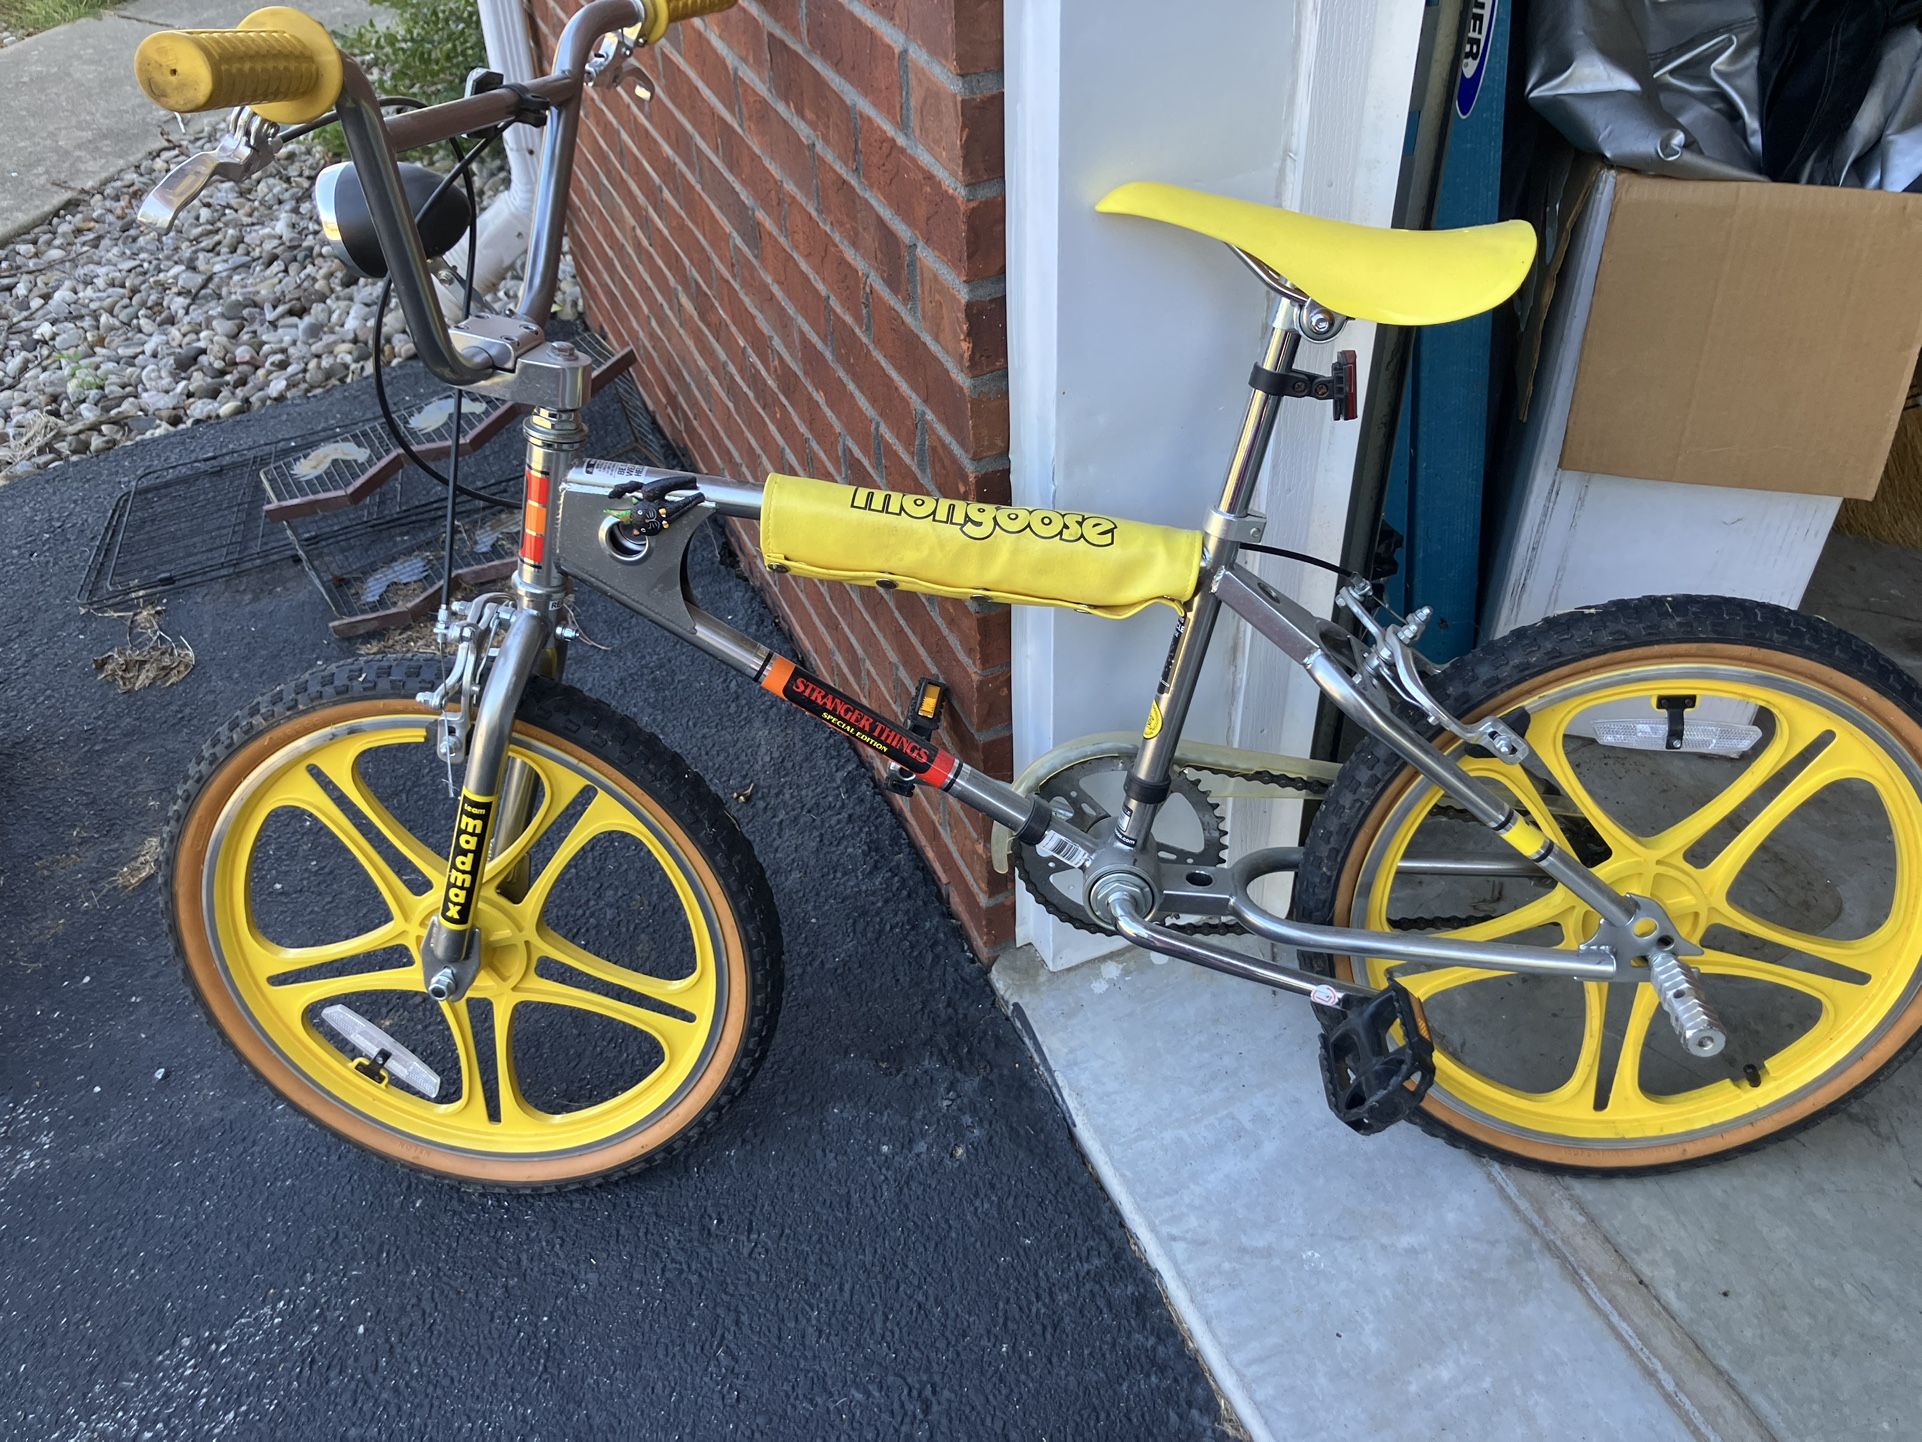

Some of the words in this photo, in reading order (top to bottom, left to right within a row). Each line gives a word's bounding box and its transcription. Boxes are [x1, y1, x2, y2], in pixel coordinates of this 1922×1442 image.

[850, 486, 1118, 547] mongoose
[792, 677, 876, 731] STRANGER
[873, 723, 929, 763] THINGS
[822, 711, 856, 735] SPECIAL
[856, 731, 888, 753] EDITION
[464, 803, 485, 815] team
